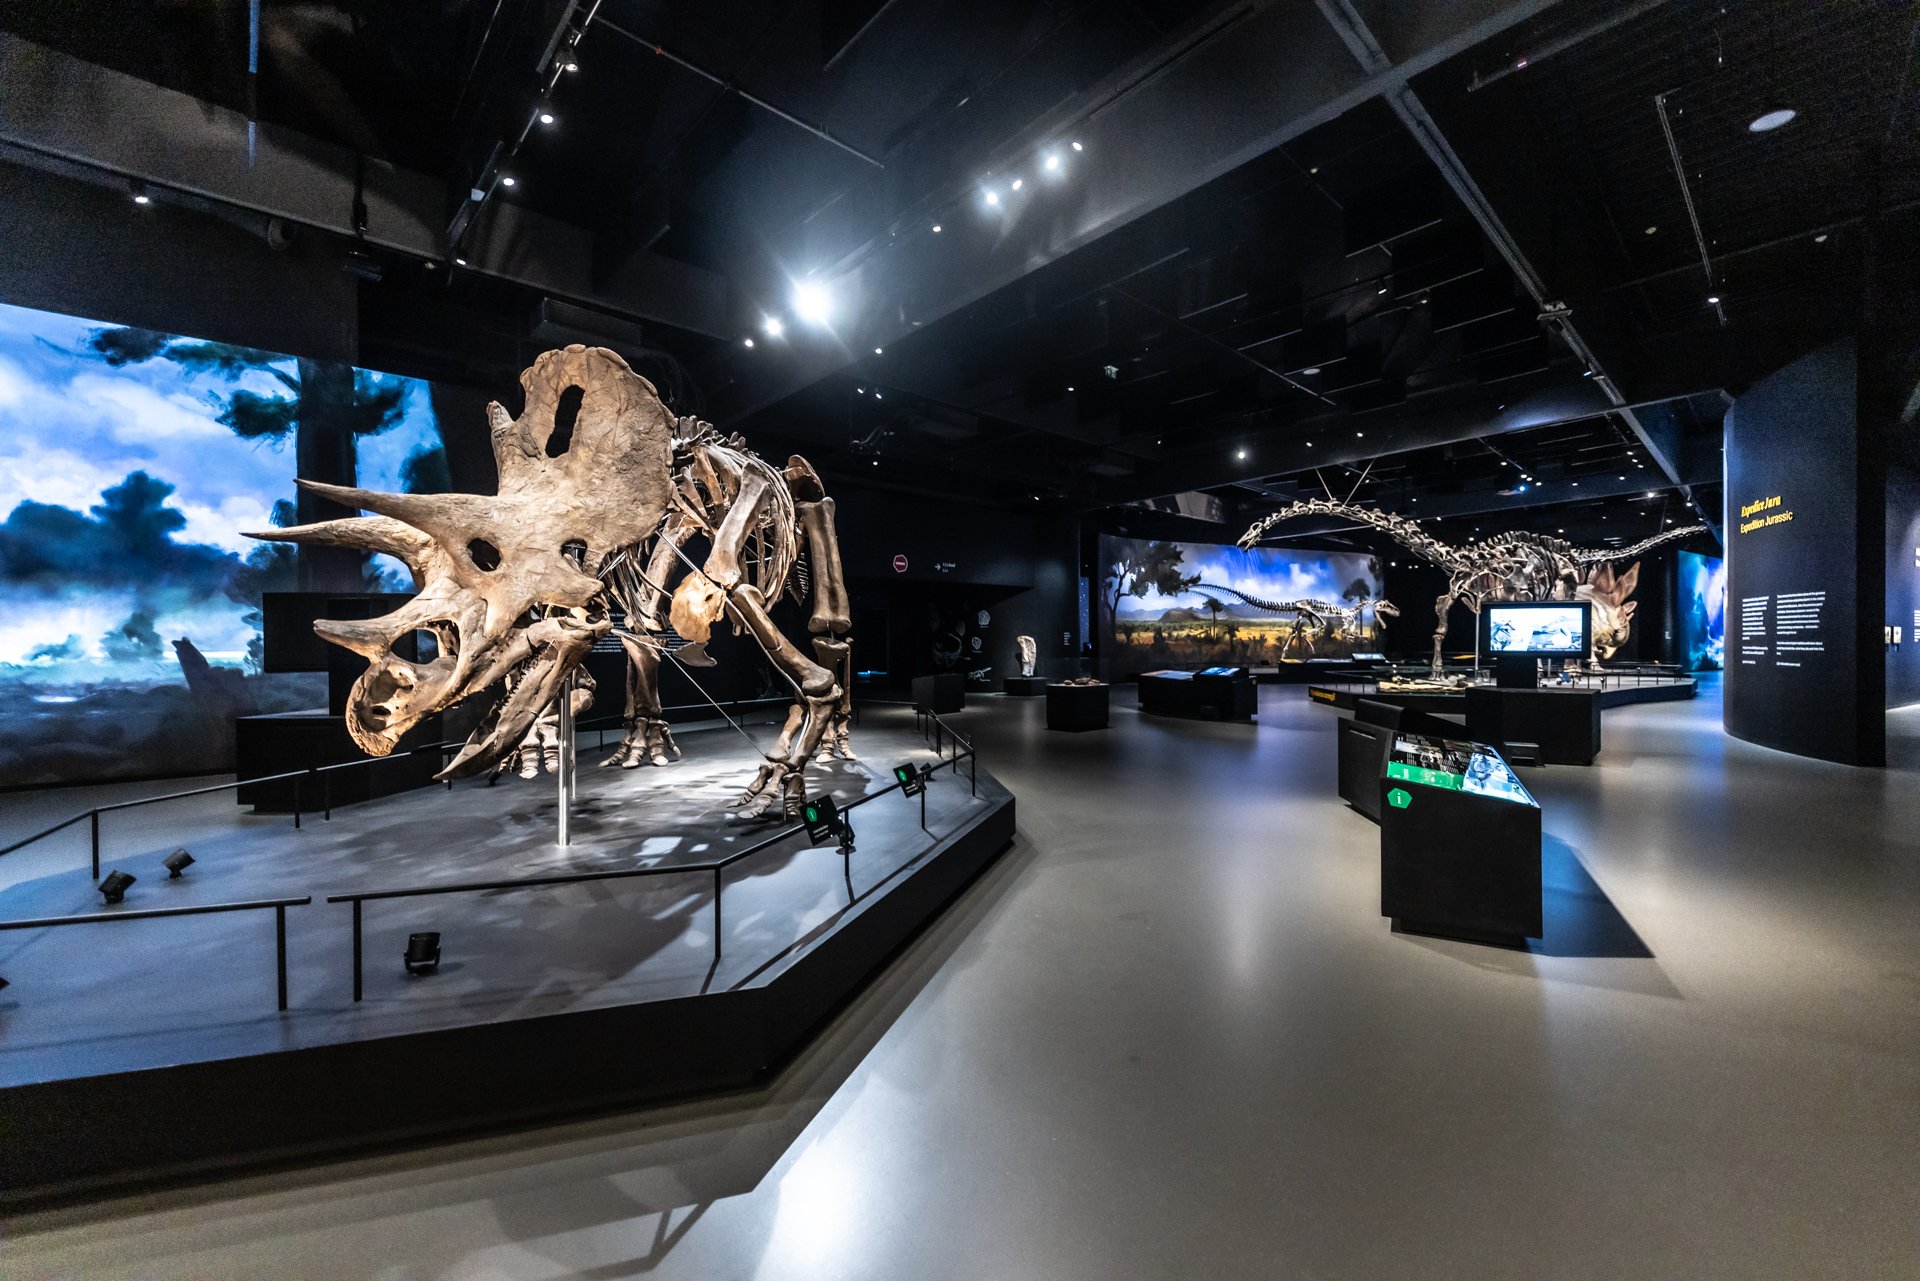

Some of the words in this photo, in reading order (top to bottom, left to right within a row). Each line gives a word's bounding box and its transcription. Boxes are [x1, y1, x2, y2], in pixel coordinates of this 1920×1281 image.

[1764, 496, 1781, 509] Jura
[1740, 519, 1764, 534] Expedition
[1765, 510, 1793, 526] Jurassic
[1397, 792, 1402, 805] i
